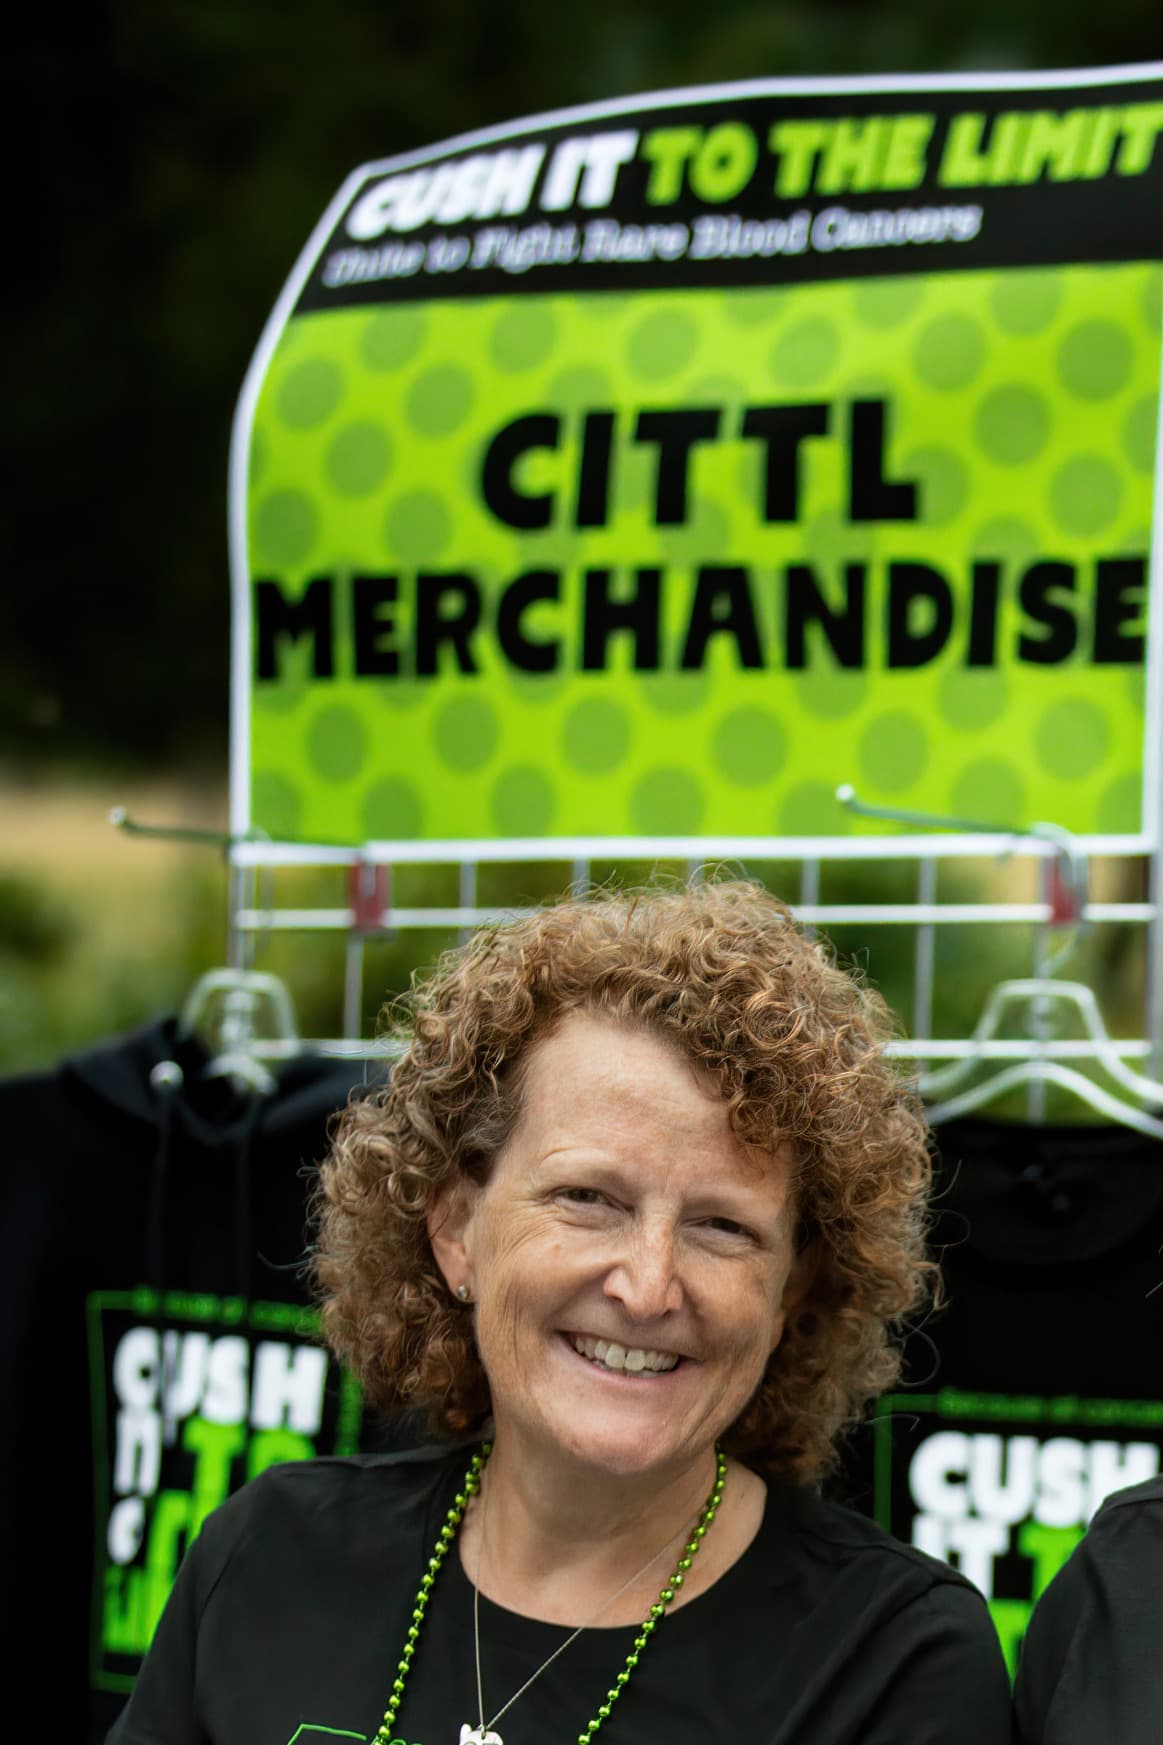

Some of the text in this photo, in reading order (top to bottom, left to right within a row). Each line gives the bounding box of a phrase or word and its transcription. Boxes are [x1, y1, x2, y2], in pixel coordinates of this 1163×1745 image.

[346, 143, 547, 241] CUSH
[540, 128, 639, 211] IT
[641, 122, 757, 206] TO
[770, 113, 935, 198] THE
[424, 235, 470, 273] to
[469, 222, 578, 275] Fight
[580, 217, 689, 262] Rare
[690, 211, 811, 259] Blood
[811, 206, 983, 253] Cancers
[480, 399, 918, 531] CITTL
[252, 555, 1150, 680] MERCHANDISE
[114, 1326, 328, 1434] CUSH
[909, 1430, 1160, 1529] CUSH
